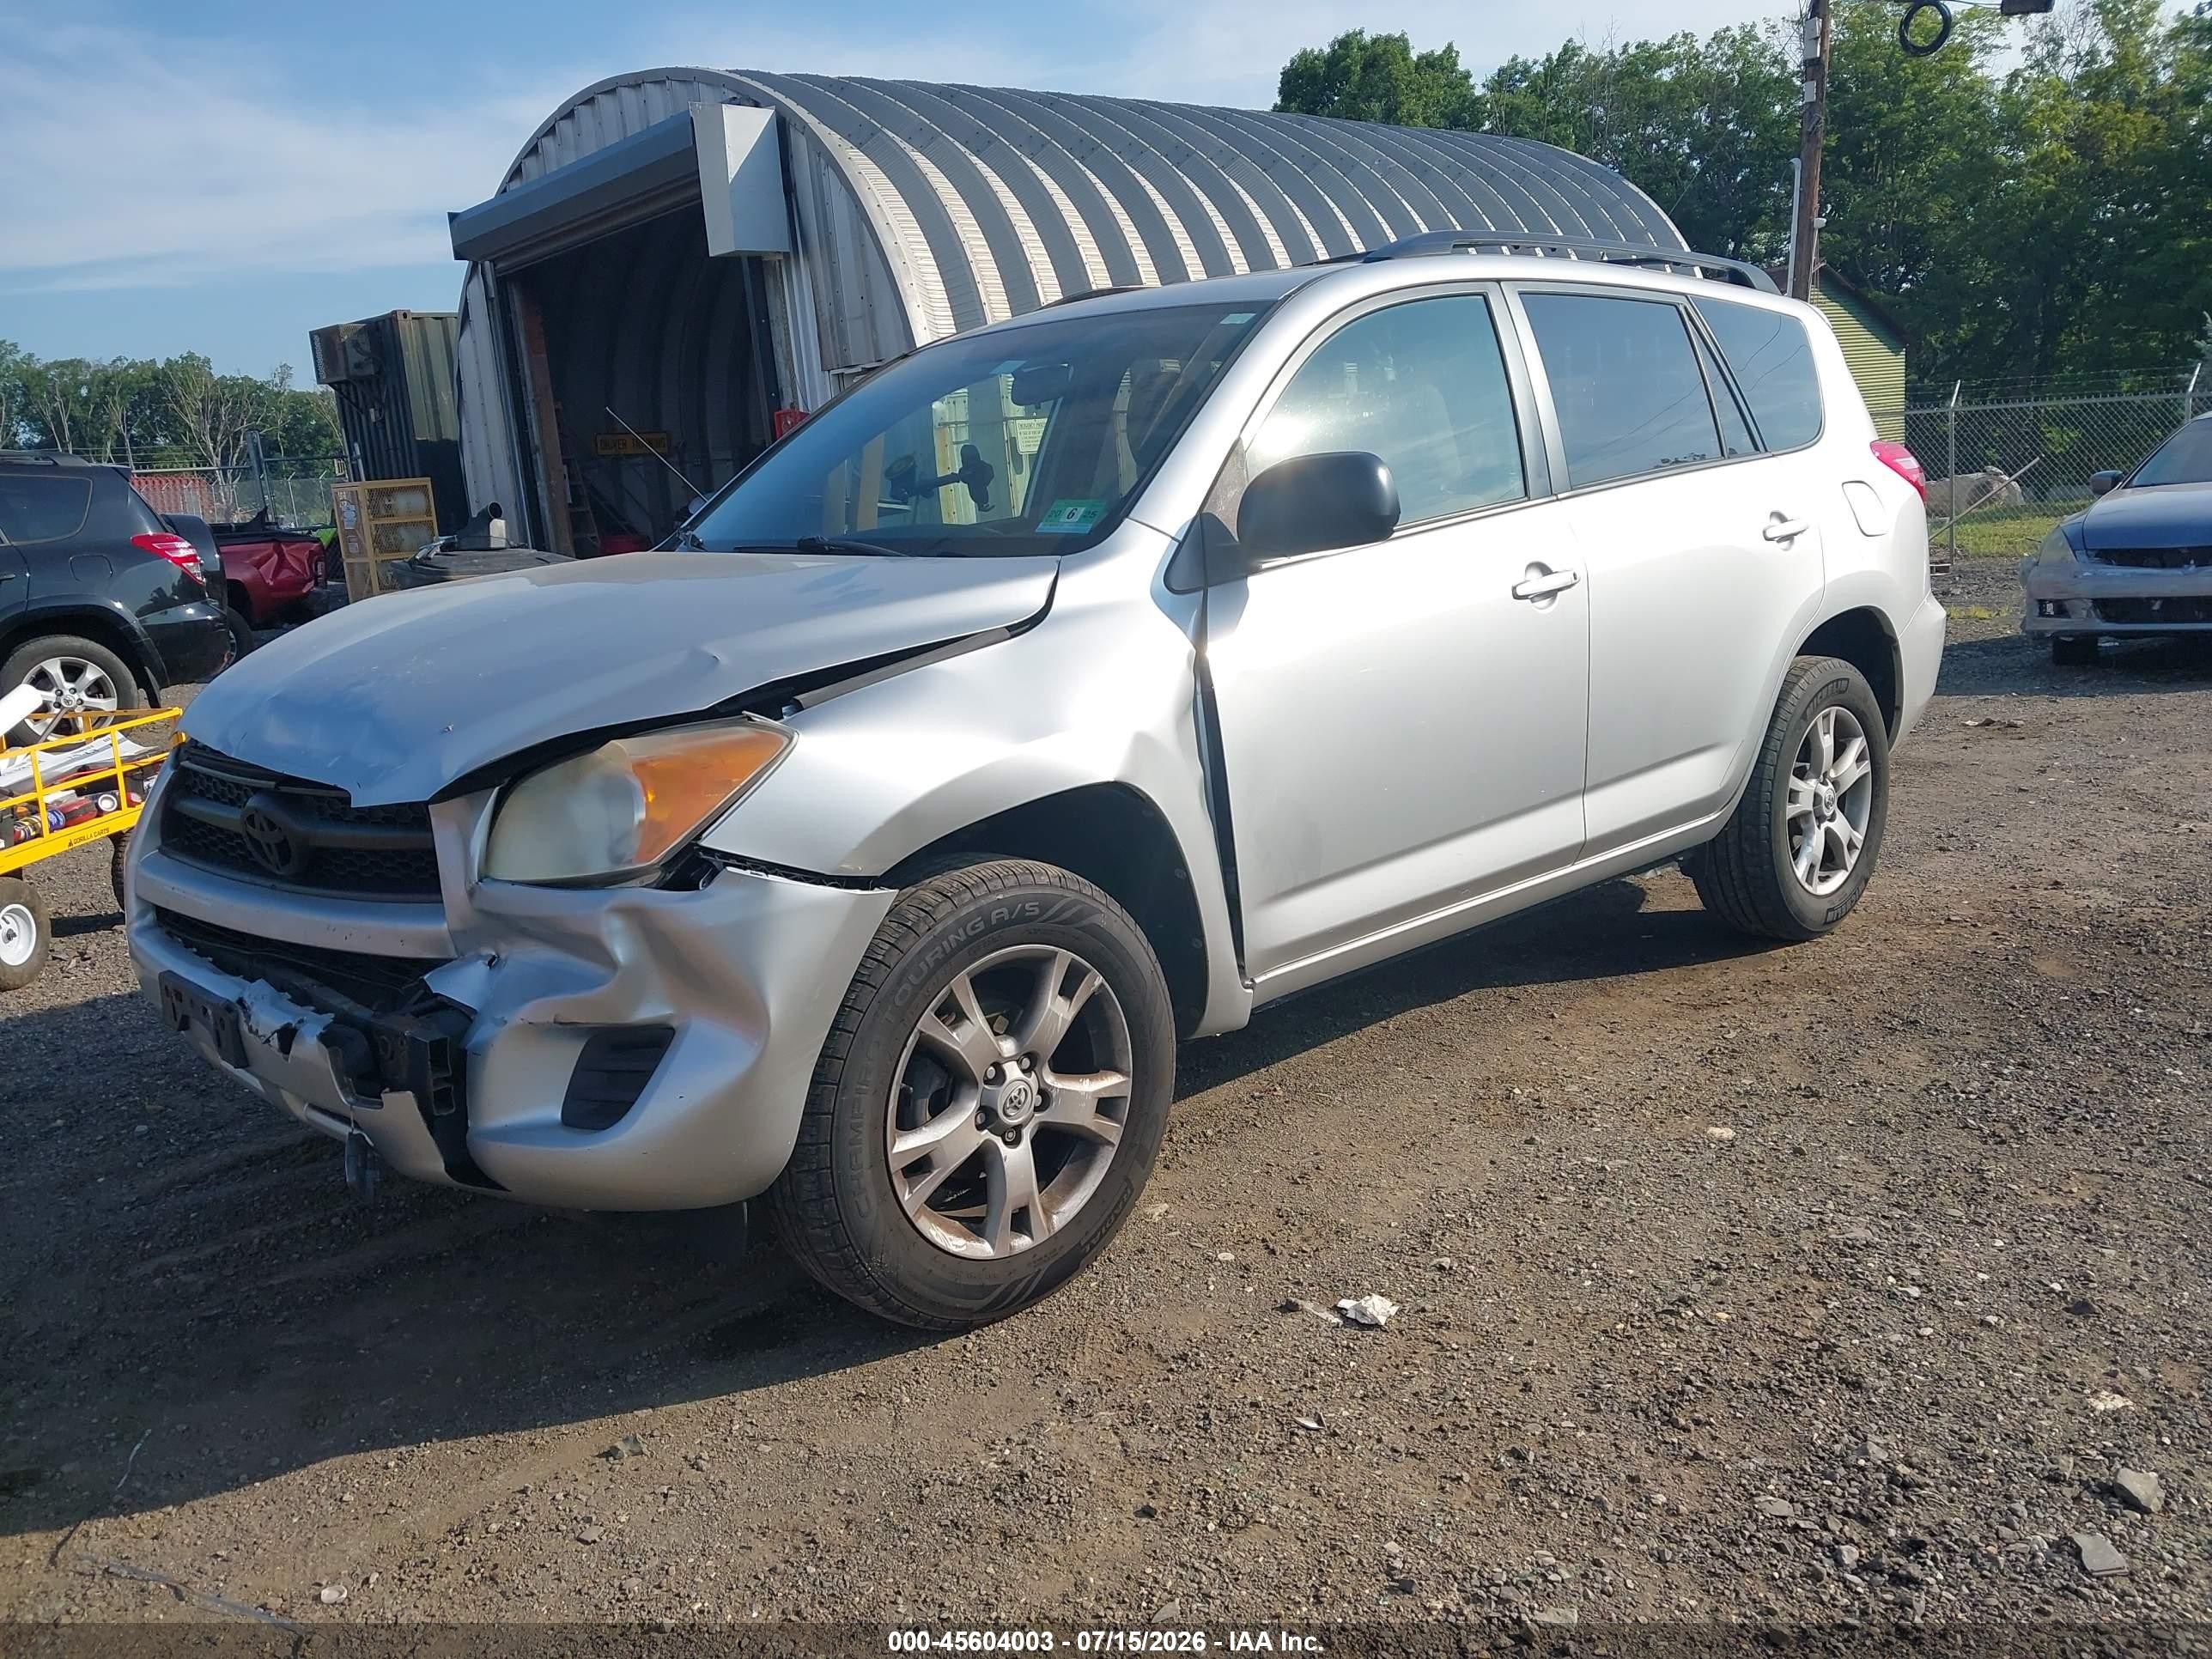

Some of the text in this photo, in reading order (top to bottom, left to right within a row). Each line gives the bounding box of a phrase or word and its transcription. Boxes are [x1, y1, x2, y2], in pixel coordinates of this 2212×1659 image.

[1066, 507, 1078, 520] 6
[73, 833, 94, 845] GORILLA
[878, 915, 985, 1024] TOURING
[990, 900, 1041, 925] A/S
